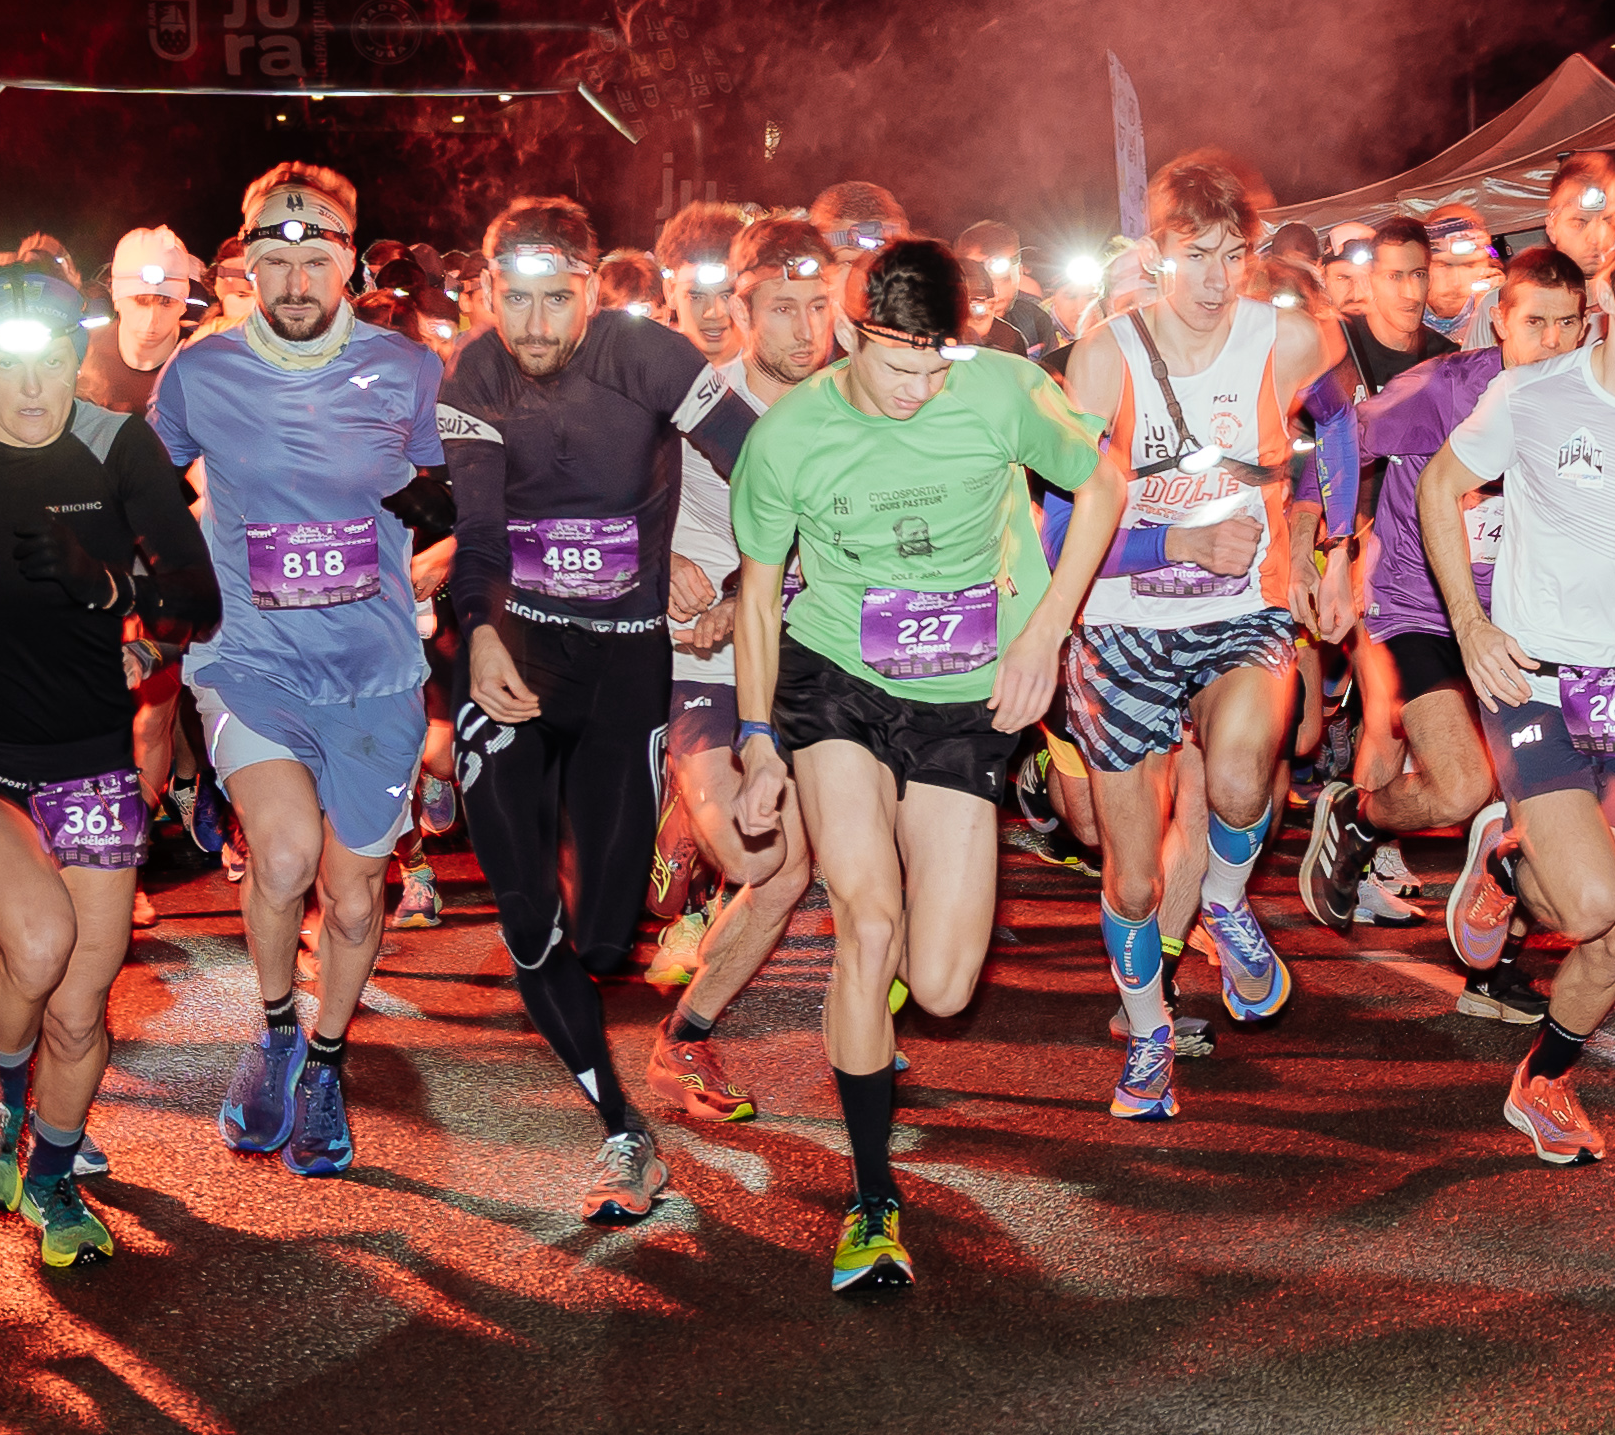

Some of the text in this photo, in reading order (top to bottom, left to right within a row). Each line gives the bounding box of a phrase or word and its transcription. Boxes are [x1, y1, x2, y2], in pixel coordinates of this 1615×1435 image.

[225, 33, 307, 77] ra
[869, 484, 948, 502] CYCLOSPORTIVE
[283, 550, 345, 579] 818
[542, 546, 603, 571] 488
[897, 614, 963, 645] 227
[904, 642, 952, 655] Clément
[64, 802, 124, 835] 361
